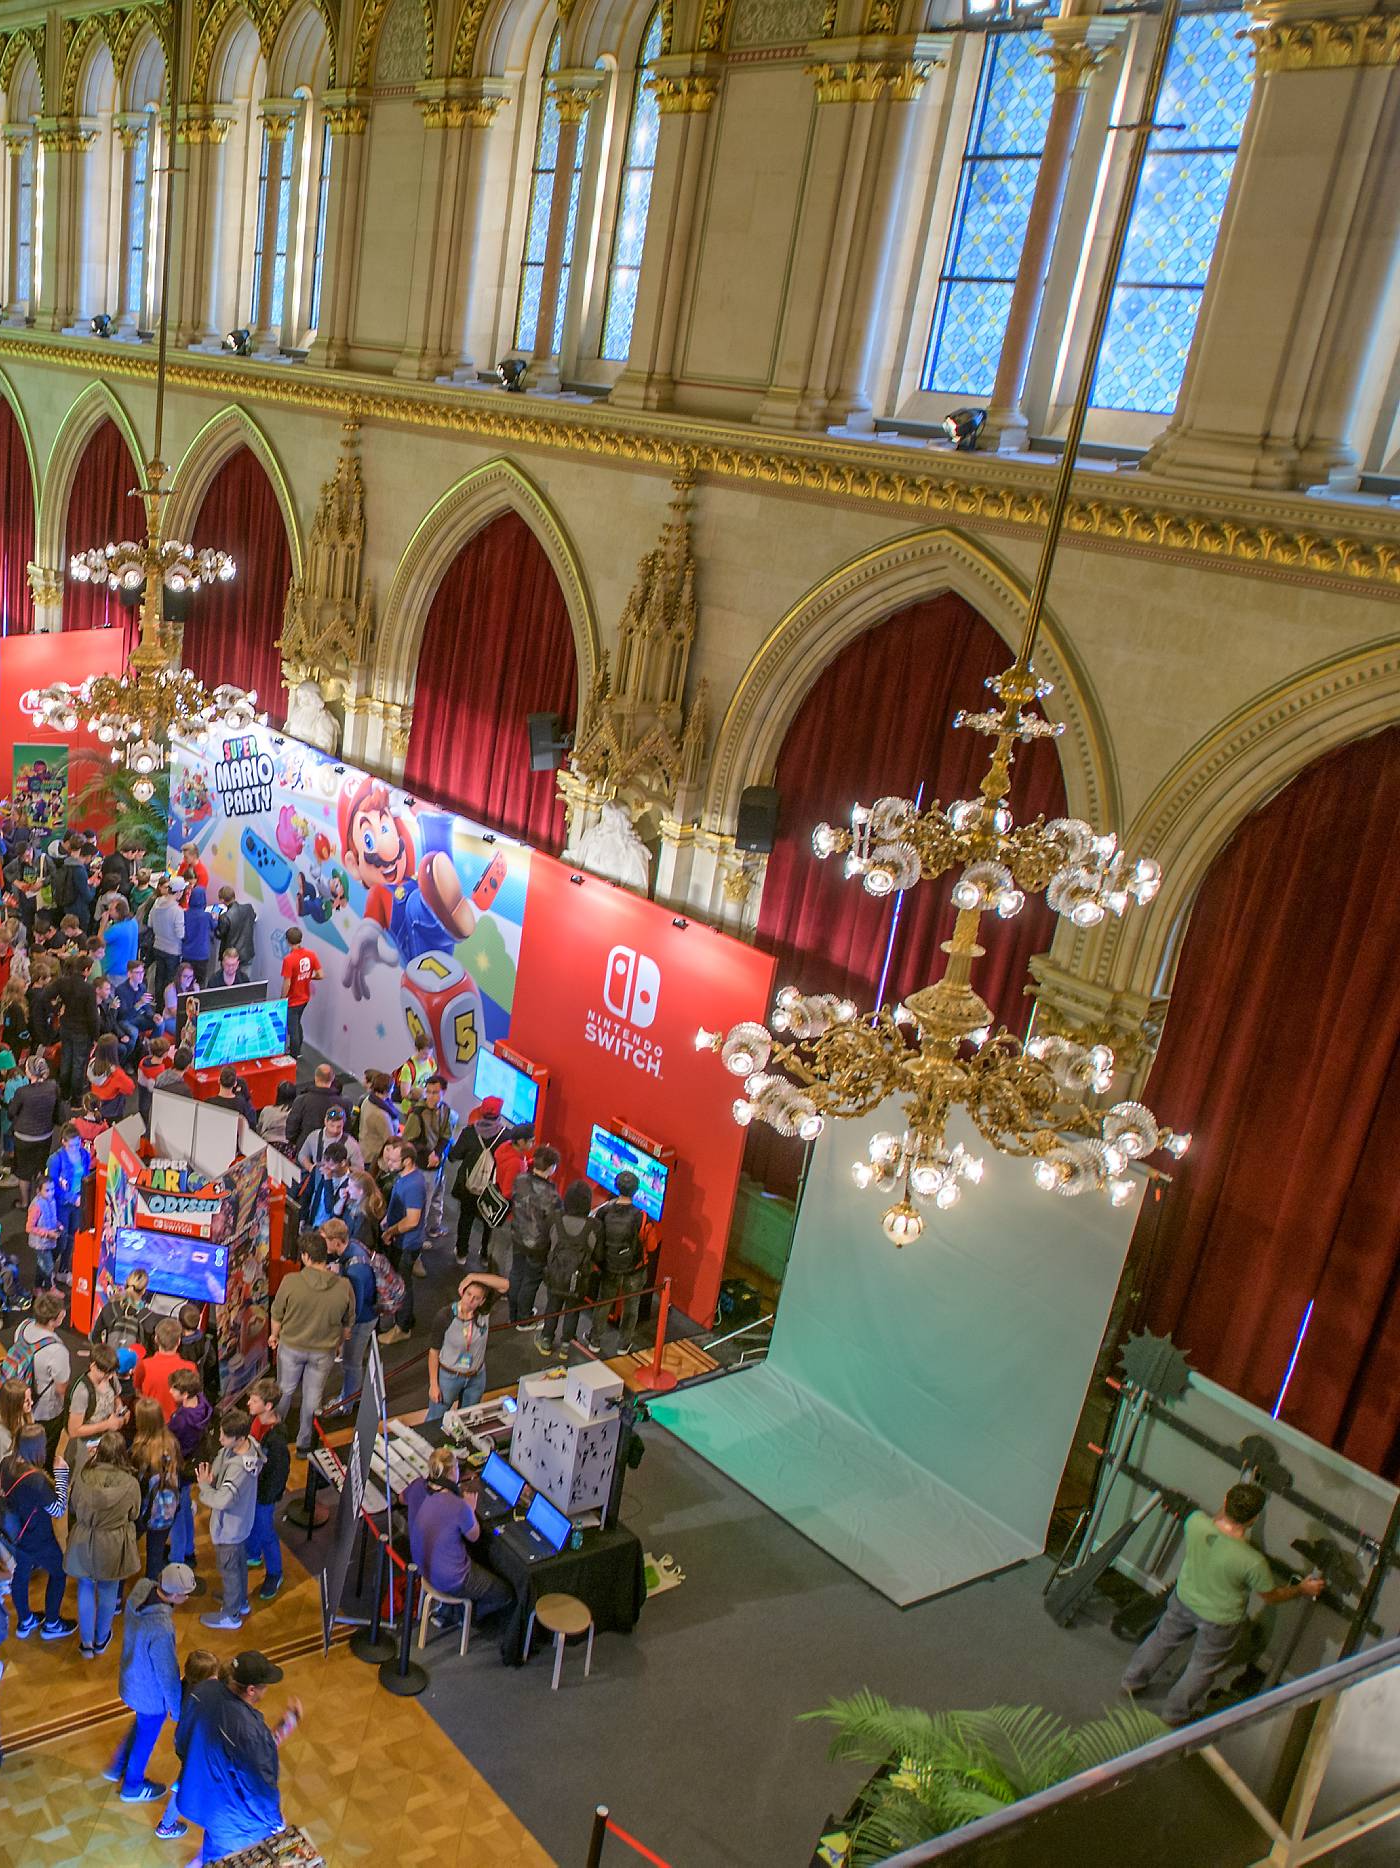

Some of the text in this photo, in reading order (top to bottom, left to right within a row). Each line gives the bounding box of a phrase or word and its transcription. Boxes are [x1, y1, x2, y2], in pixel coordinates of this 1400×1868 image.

[223, 735, 258, 761] SUPER
[215, 753, 274, 793] MARIO
[223, 784, 272, 817] PARTY
[454, 1009, 478, 1065] 5
[585, 1023, 662, 1078] SWITCH
[587, 1009, 664, 1058] NINTENDO
[137, 1169, 207, 1193] MARIO
[150, 1159, 188, 1170] SUPER
